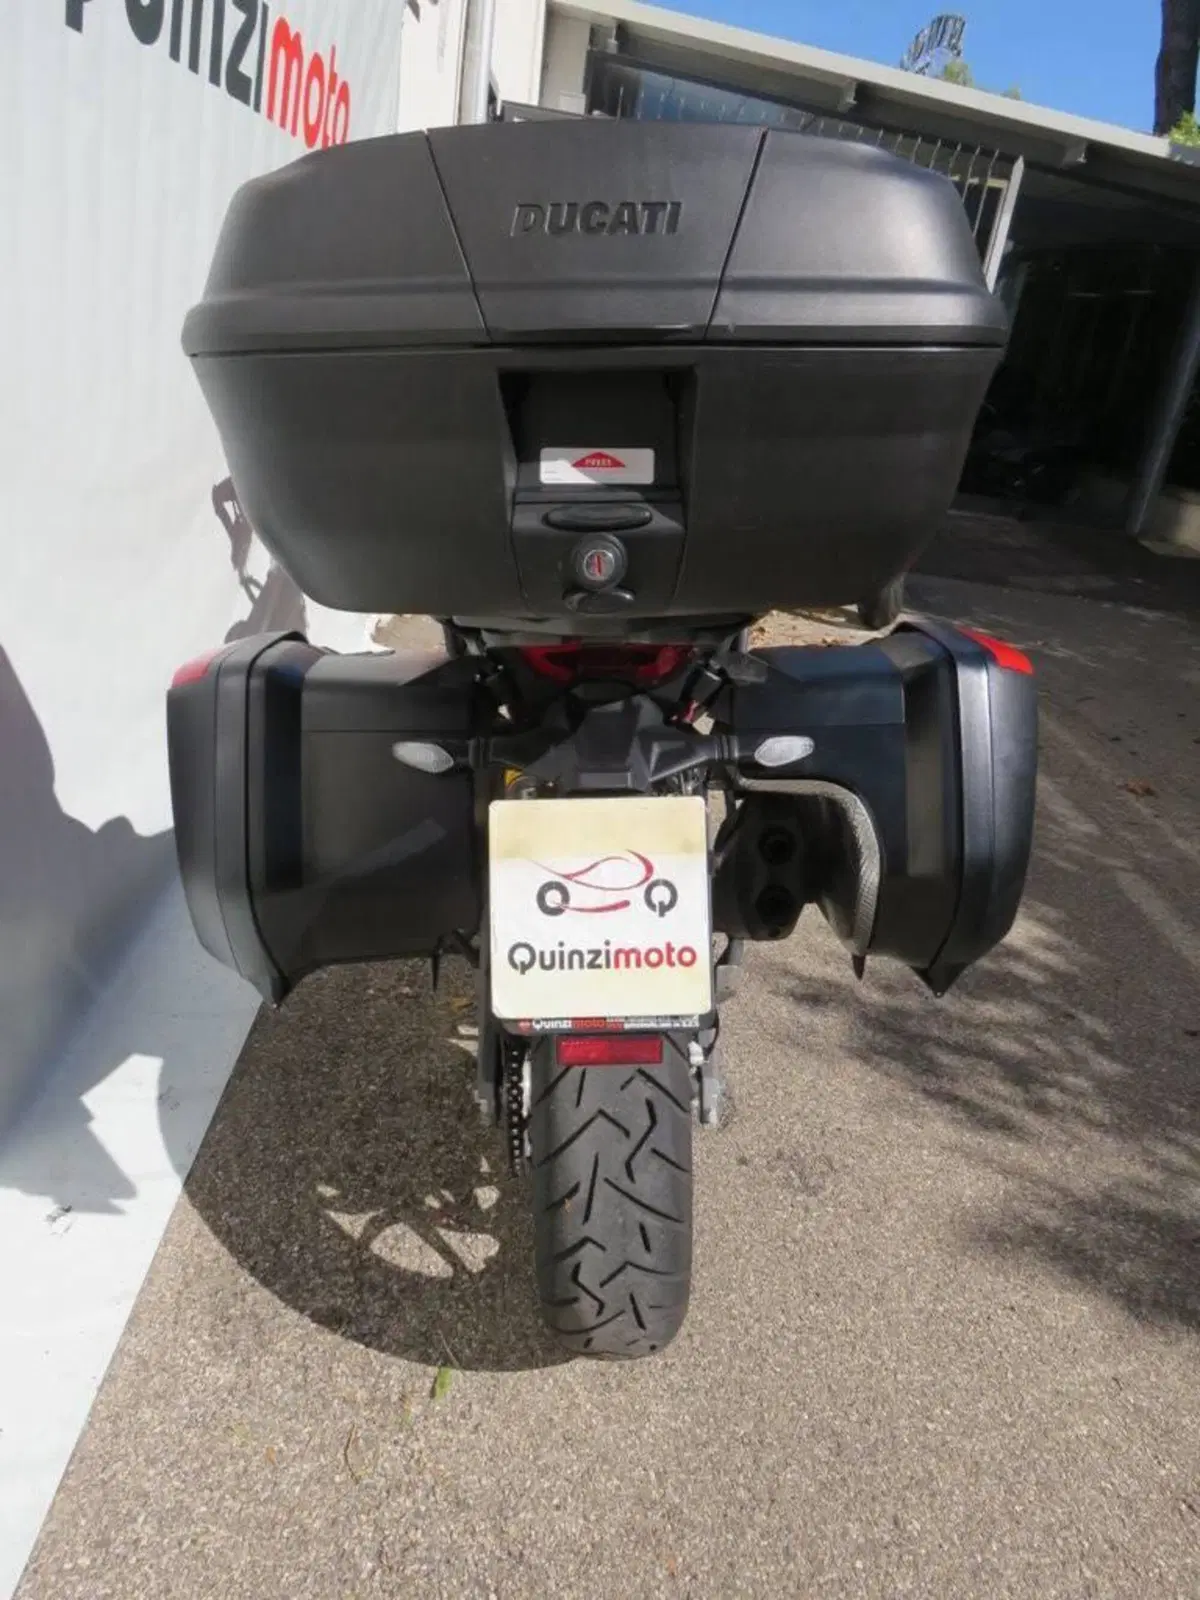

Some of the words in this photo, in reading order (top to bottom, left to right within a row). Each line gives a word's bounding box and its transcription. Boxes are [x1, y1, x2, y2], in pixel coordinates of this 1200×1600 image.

[65, 0, 350, 150] nzimoto
[510, 201, 681, 236] DUCATI
[508, 939, 697, 975] Quinzimoto
